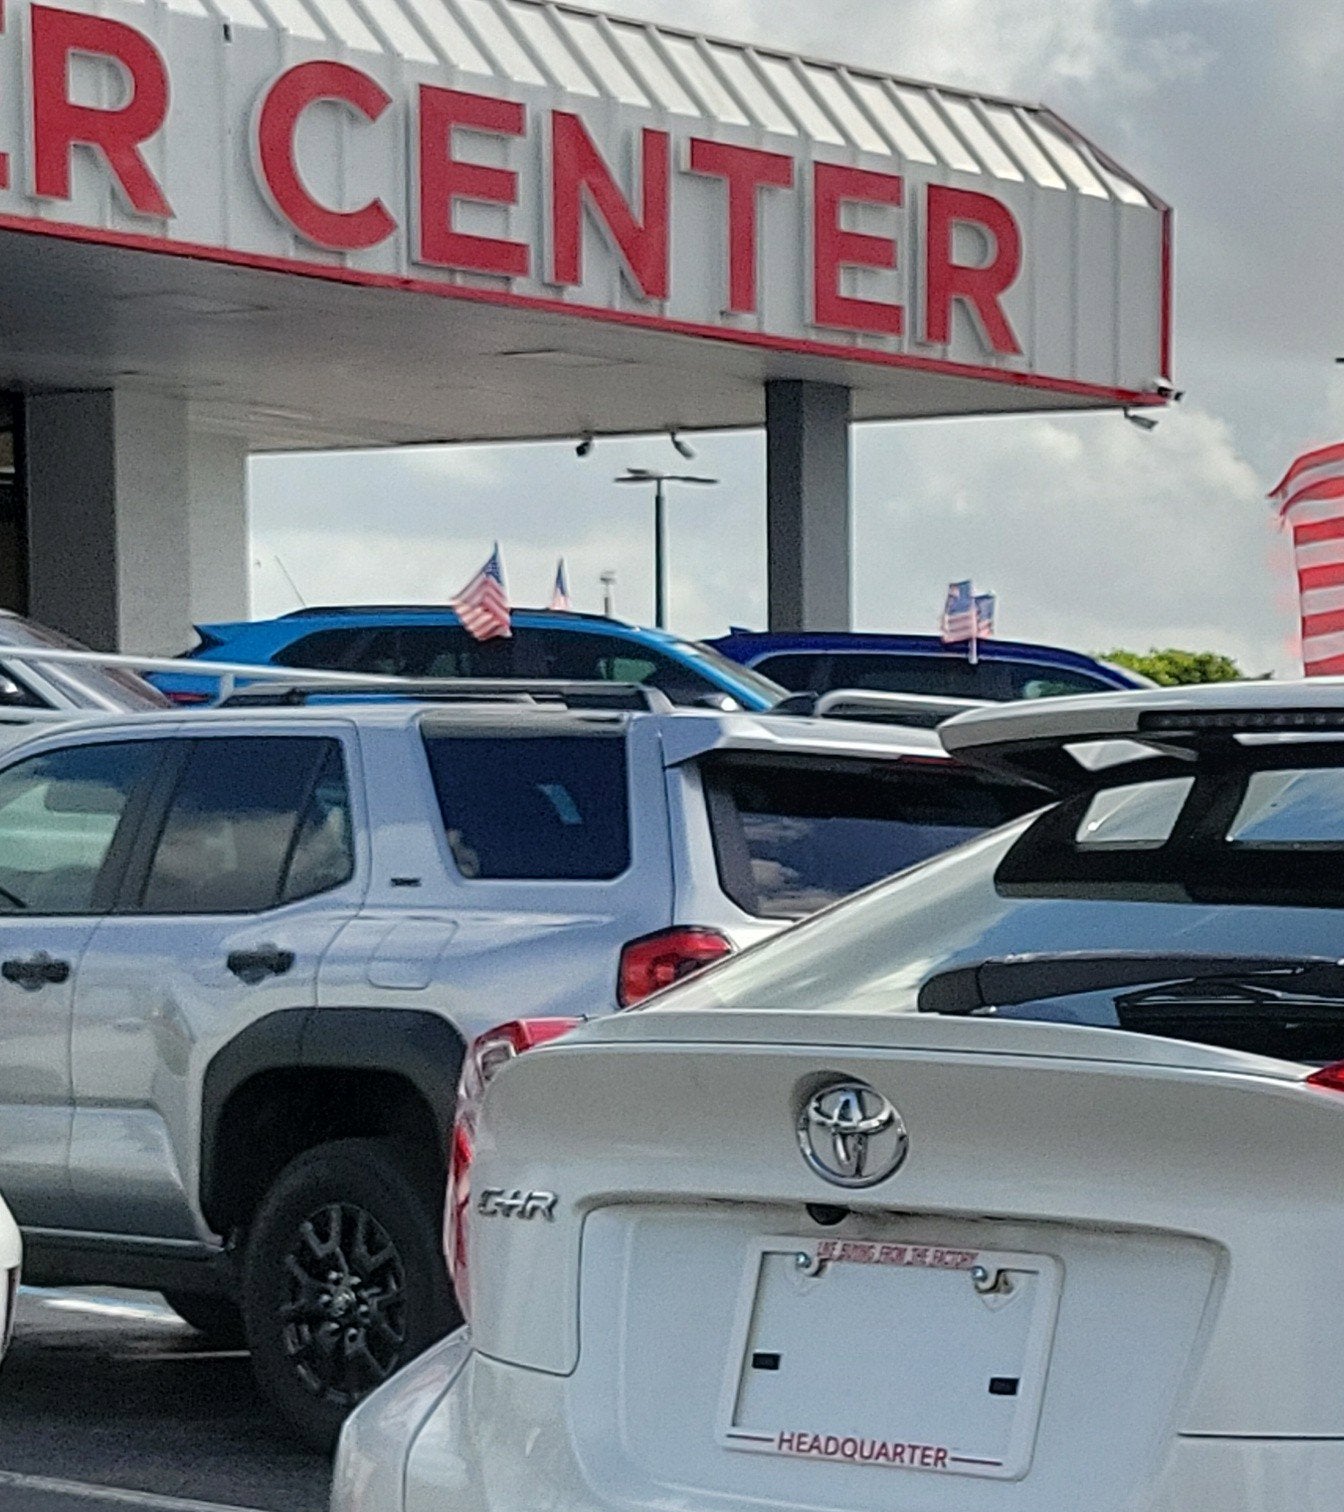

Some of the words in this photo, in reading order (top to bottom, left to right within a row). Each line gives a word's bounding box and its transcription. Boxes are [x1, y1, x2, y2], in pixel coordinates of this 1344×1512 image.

[0, 0, 176, 219] R
[256, 59, 1024, 356] CENTER
[777, 1431, 949, 1468] HEADQUARTER
